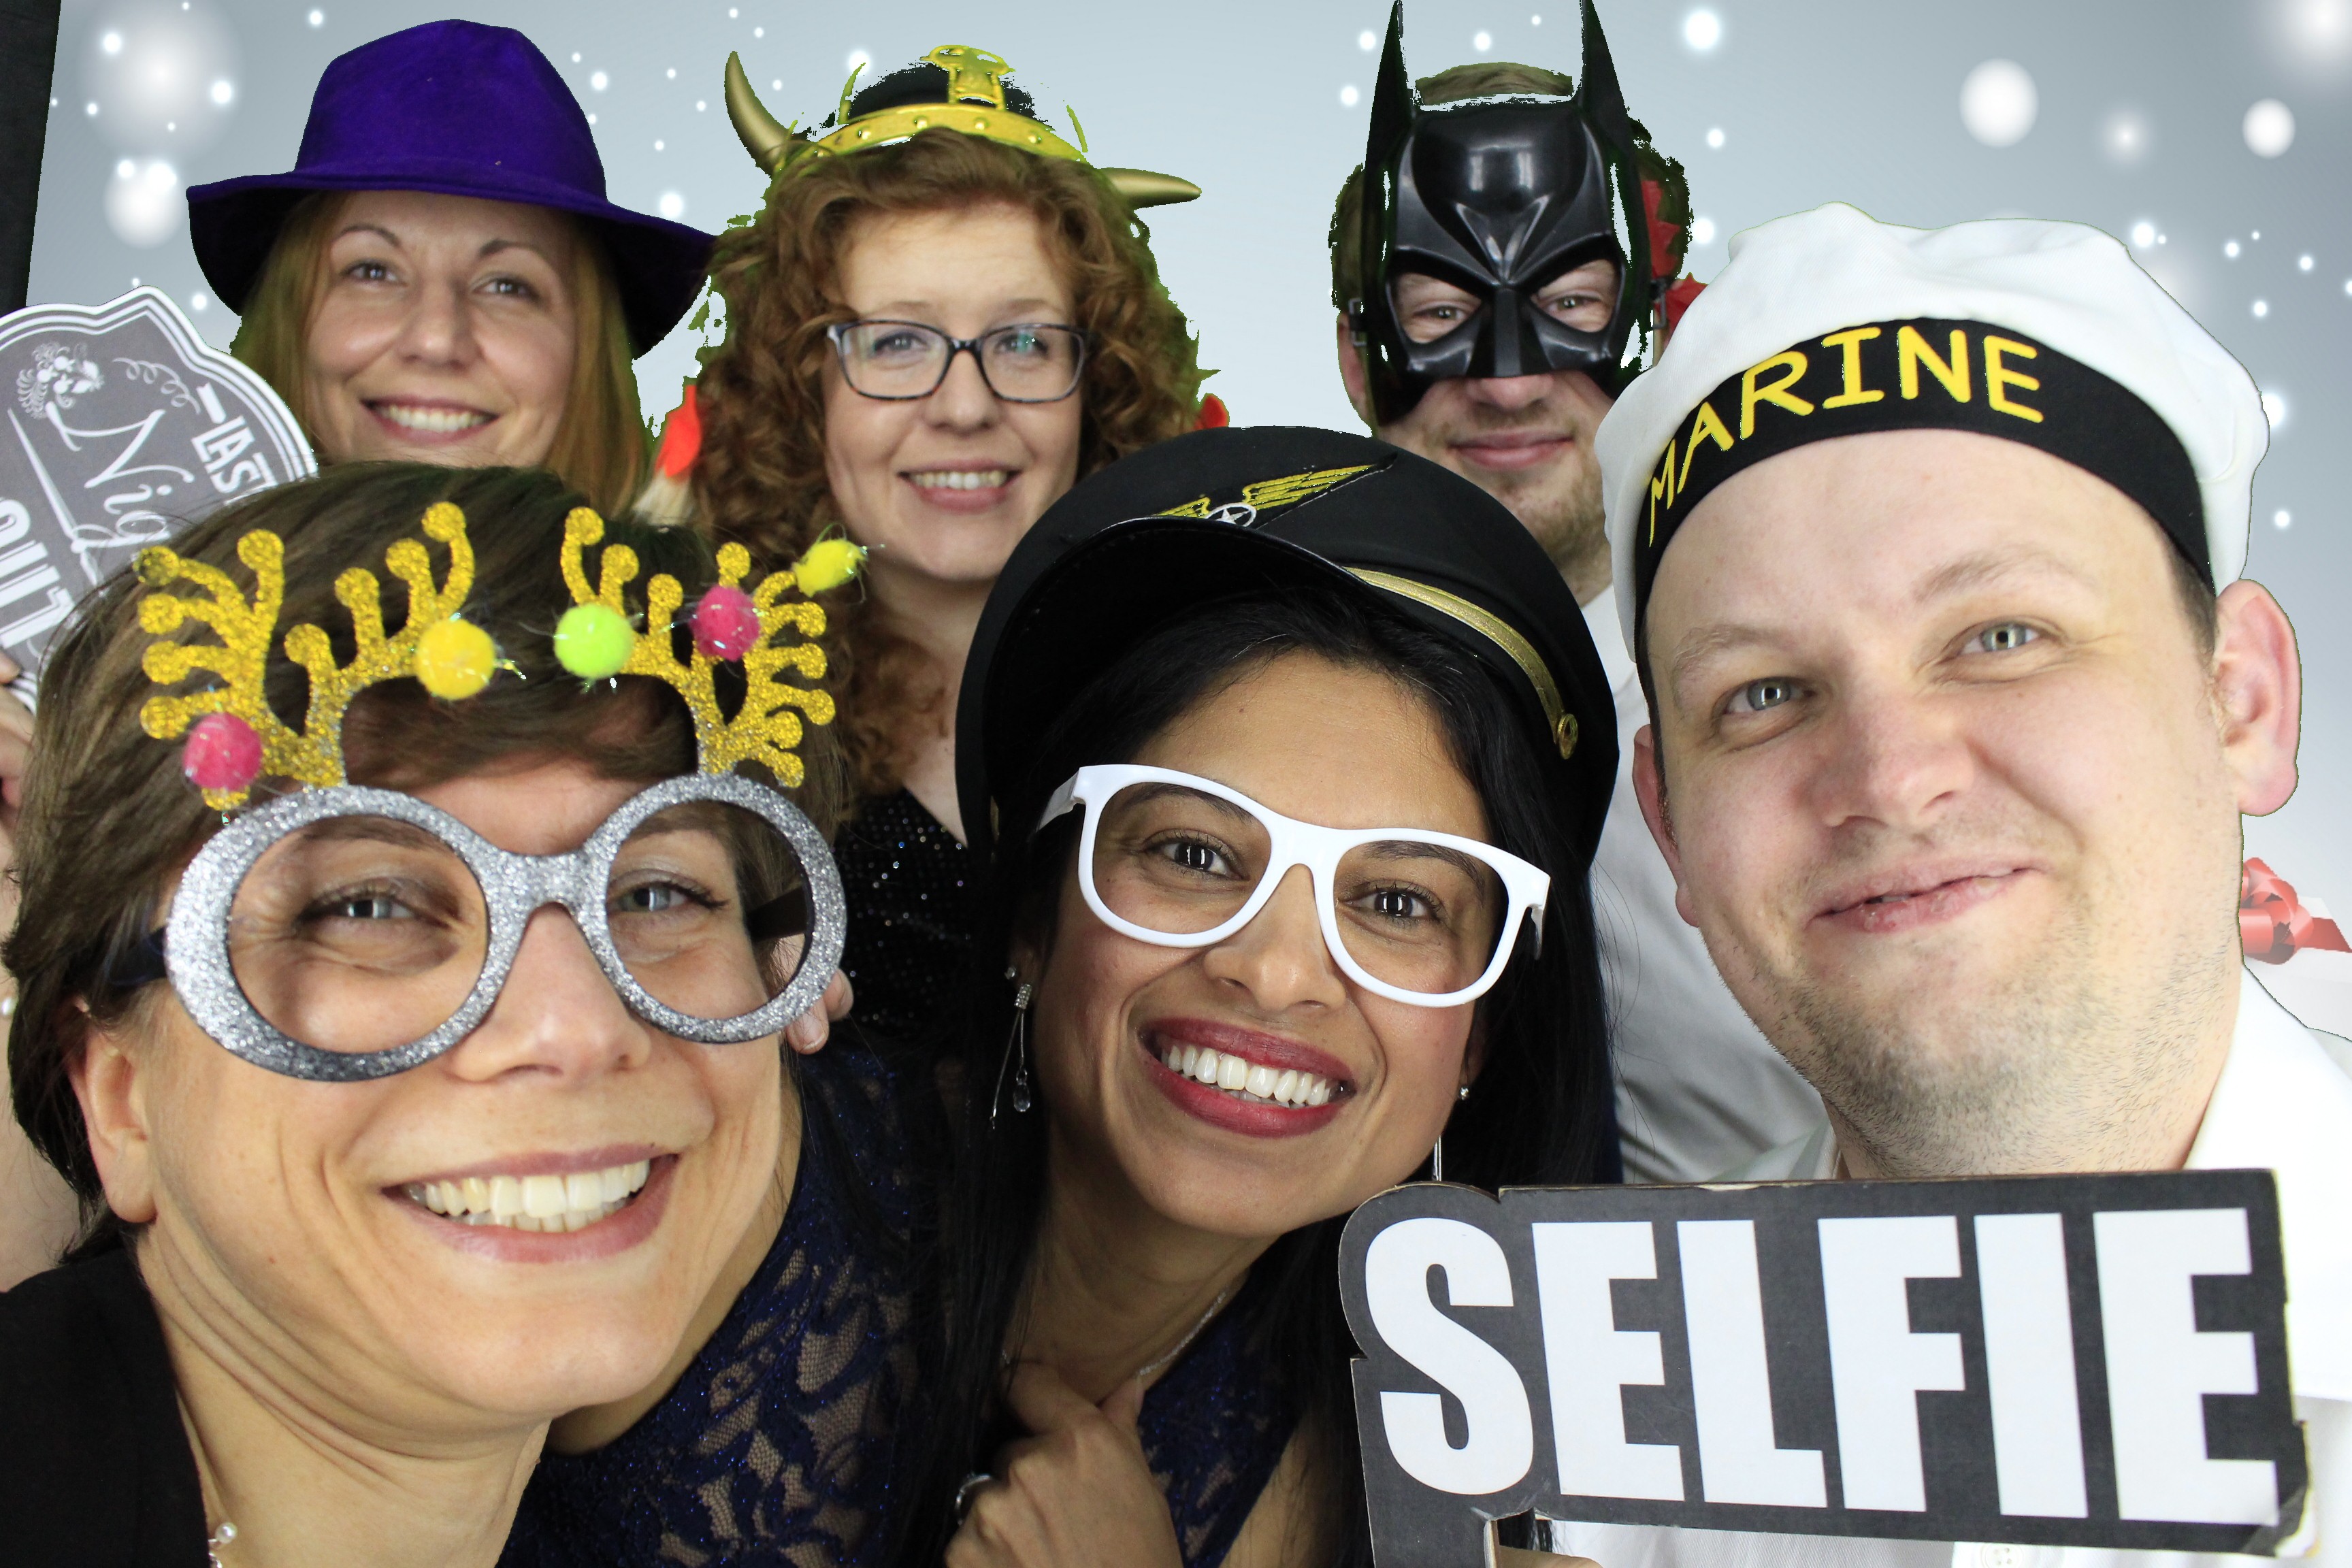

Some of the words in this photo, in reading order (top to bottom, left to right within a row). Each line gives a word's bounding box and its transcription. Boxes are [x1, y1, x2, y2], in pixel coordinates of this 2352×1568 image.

[46, 402, 195, 550] Nig
[191, 415, 278, 506] LAST
[1649, 326, 2044, 547] MARINE
[1365, 1208, 2278, 1524] SELFIE
